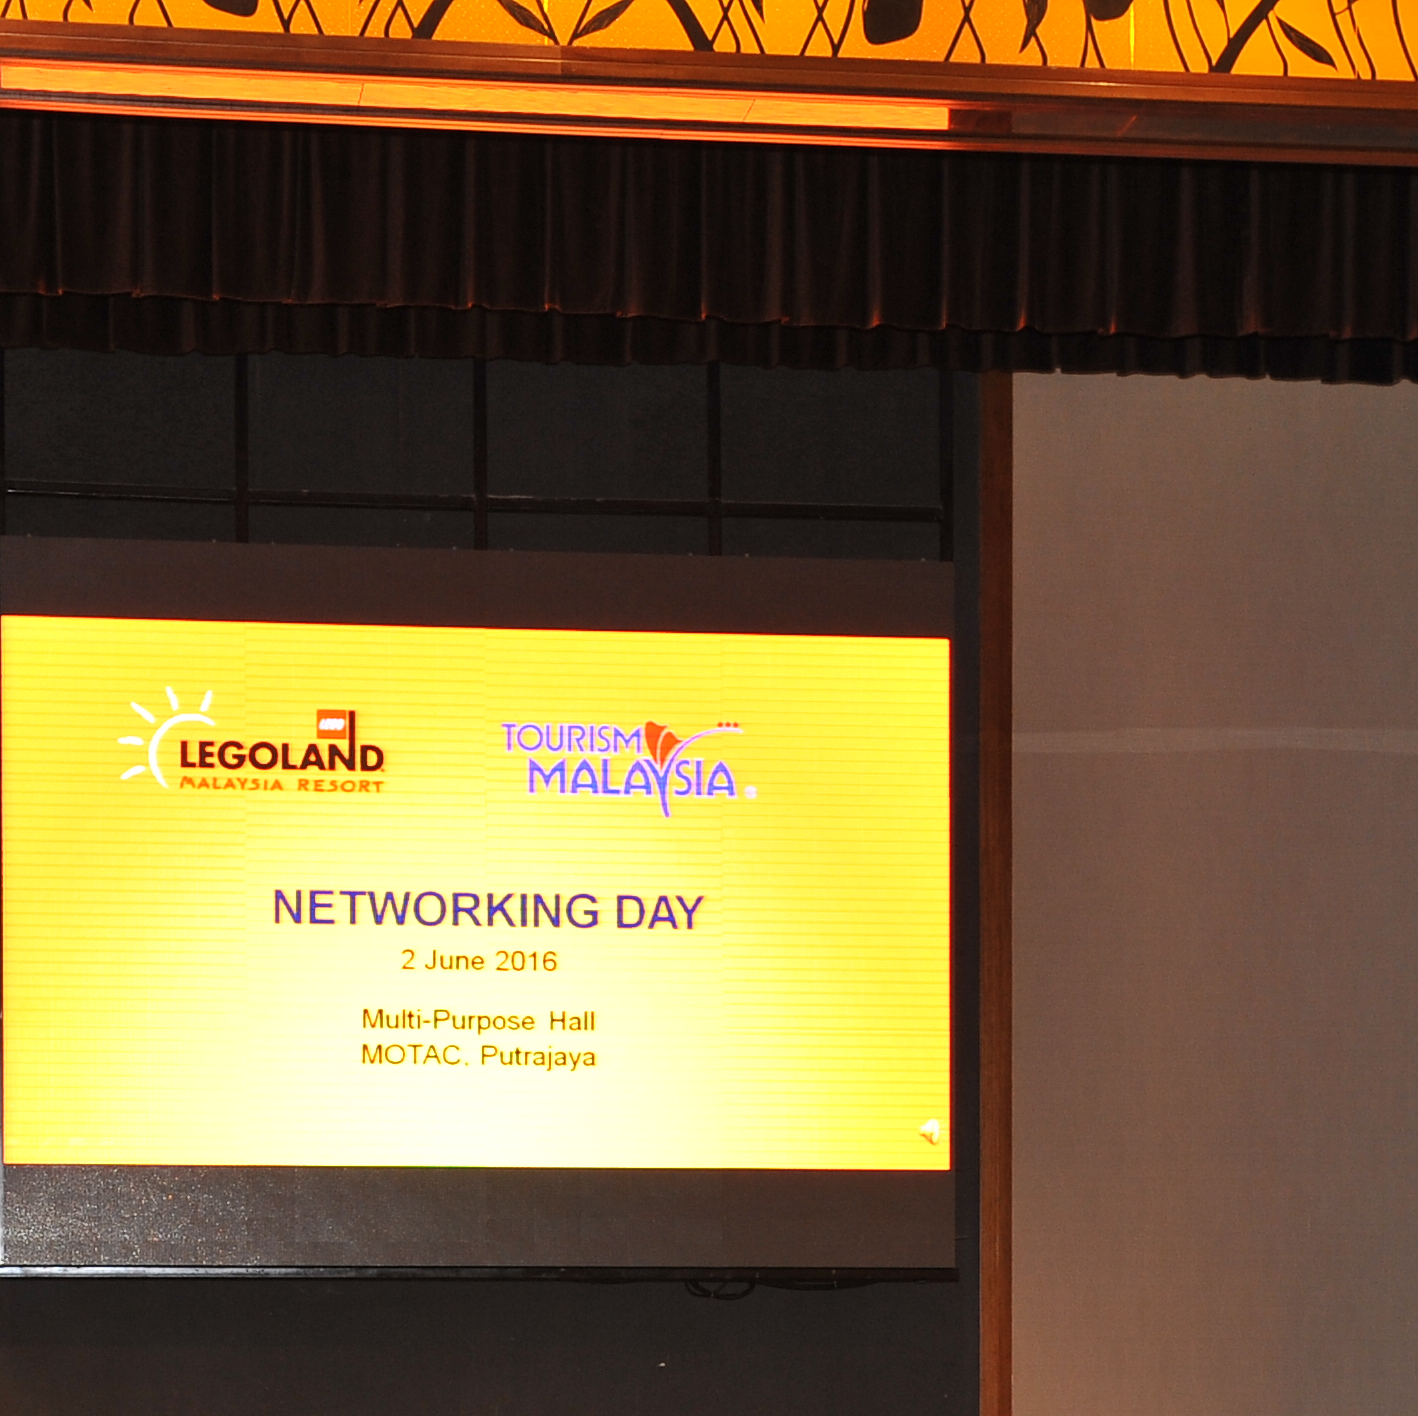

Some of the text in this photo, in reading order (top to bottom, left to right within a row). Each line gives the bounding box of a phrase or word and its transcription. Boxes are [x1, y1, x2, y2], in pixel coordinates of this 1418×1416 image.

[180, 709, 384, 772] LEGOLAND
[501, 723, 642, 753] TOURISM
[180, 776, 384, 793] MALAYSIA RESORT
[528, 757, 736, 817] MALAYSIA
[274, 889, 705, 930] NETWORKING DAY
[402, 949, 558, 972] 2 June 2016
[362, 1008, 595, 1036] Multi-Purpose Hall
[481, 1045, 596, 1072] Putrajaya
